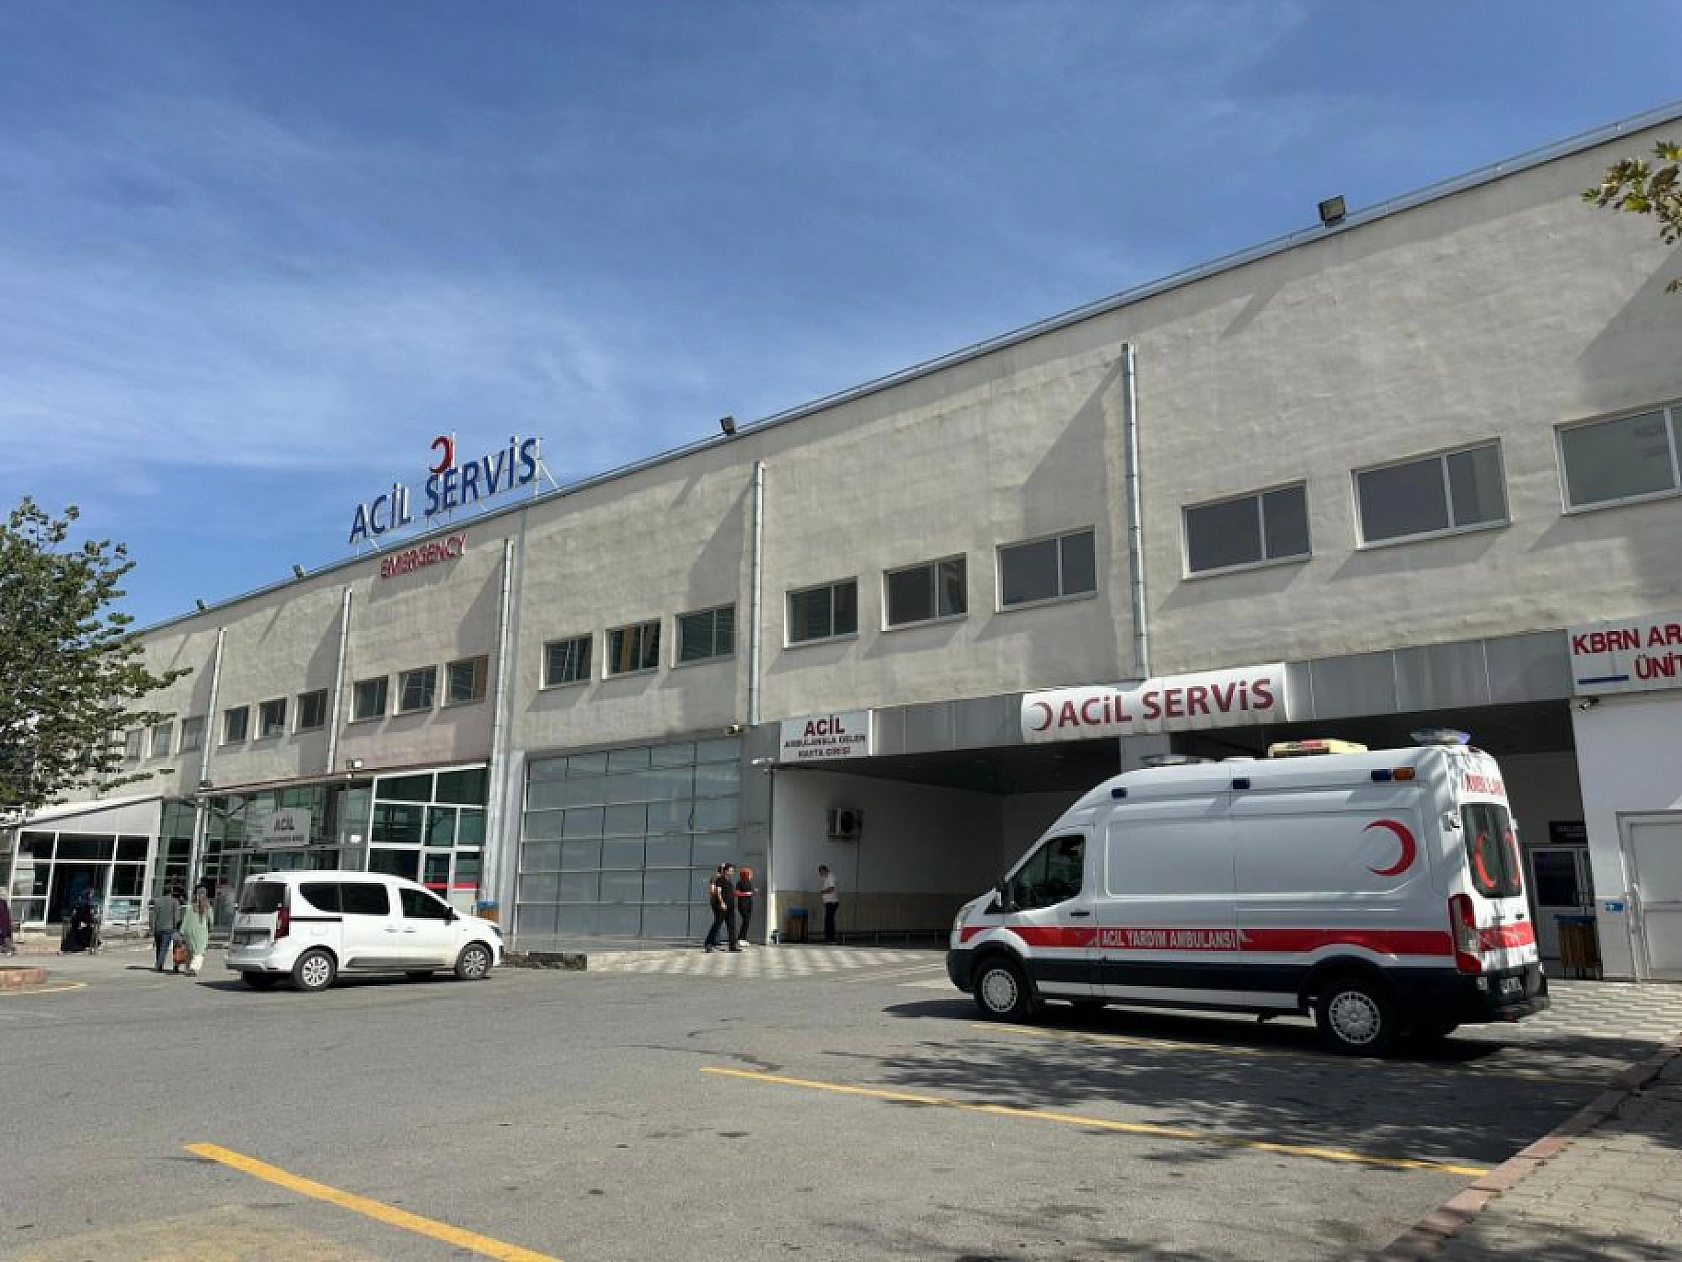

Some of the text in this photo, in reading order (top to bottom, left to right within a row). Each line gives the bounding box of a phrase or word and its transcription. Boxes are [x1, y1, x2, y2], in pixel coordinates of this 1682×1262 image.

[380, 533, 468, 578] EMERGENCY
[1572, 627, 1640, 655] KBRN
[804, 712, 845, 736] ACİL
[1127, 930, 1166, 948] YARDIM
